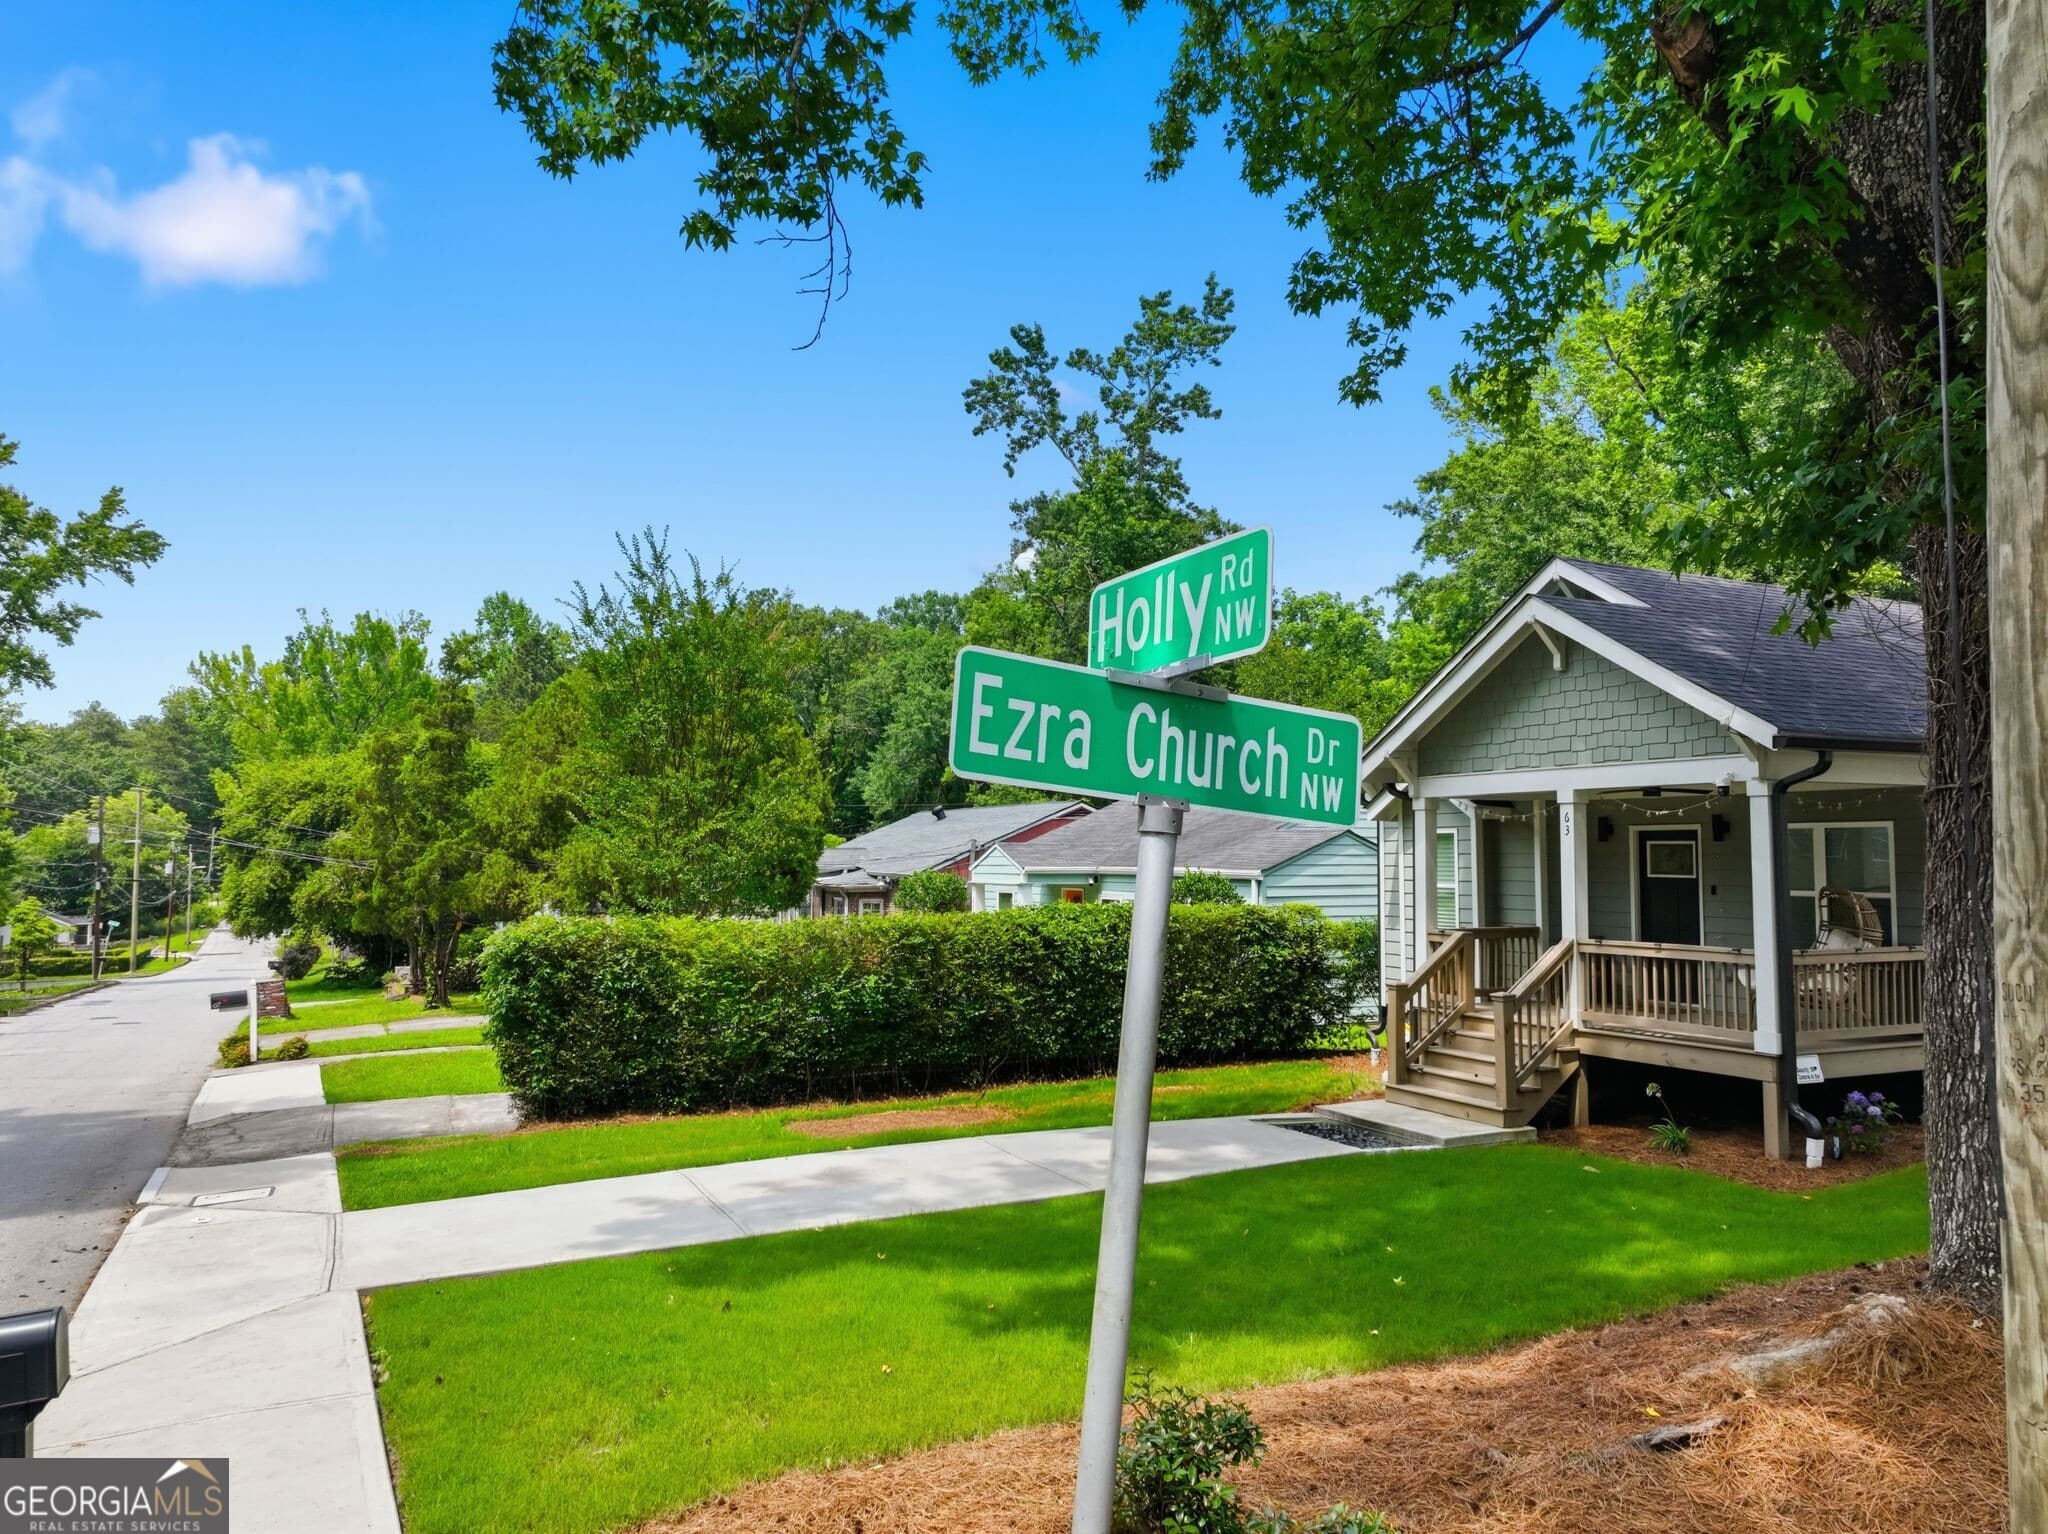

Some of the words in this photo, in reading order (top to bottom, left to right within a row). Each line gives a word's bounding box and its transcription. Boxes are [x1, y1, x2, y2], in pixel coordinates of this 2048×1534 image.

[1097, 568, 1213, 662] Holly
[1220, 547, 1254, 594] Rd
[1213, 597, 1257, 645] NW
[968, 671, 1093, 770] Ezra
[1125, 701, 1290, 800] Church
[1306, 727, 1341, 767] Dr
[1299, 772, 1344, 814] NW
[1564, 812, 1570, 836] 63
[2020, 1082, 2046, 1104] 35
